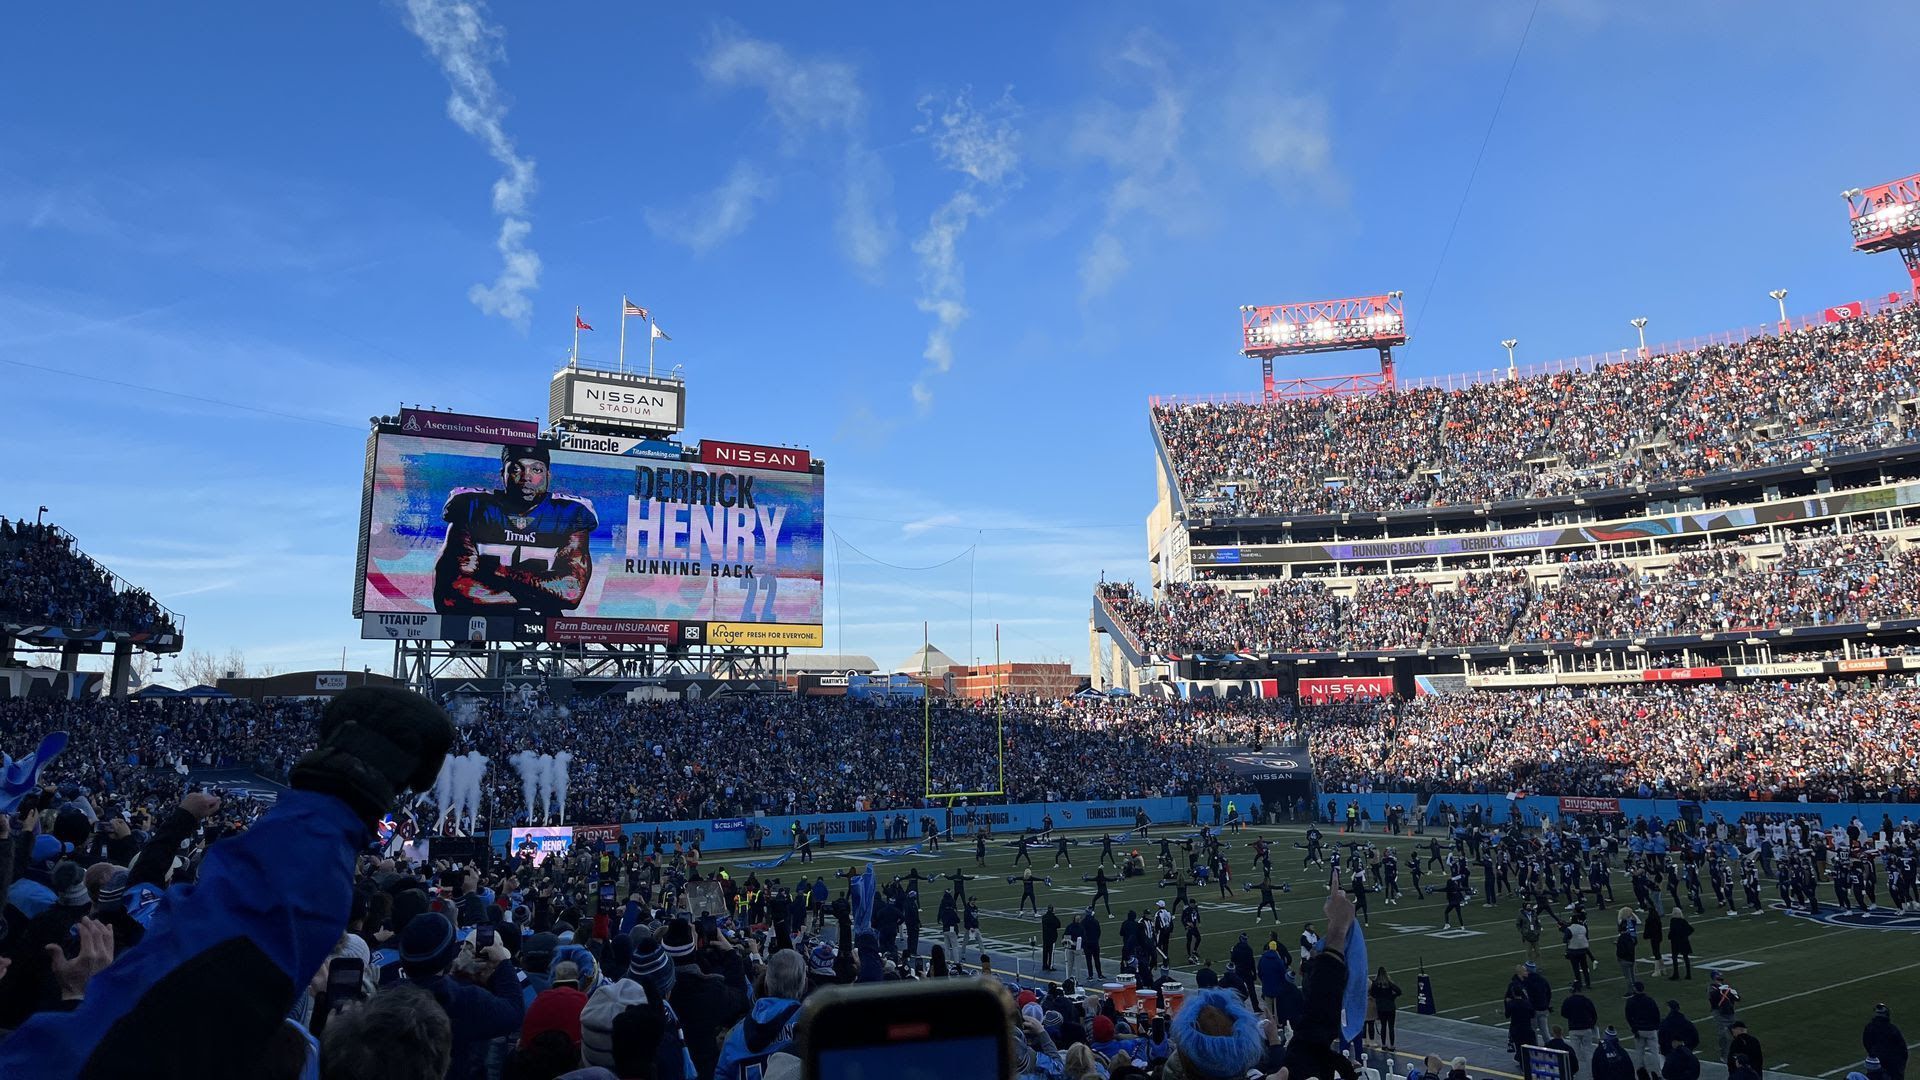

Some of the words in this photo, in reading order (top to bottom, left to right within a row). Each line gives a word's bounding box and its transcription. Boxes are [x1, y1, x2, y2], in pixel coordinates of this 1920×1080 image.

[586, 388, 664, 407] NISSAN
[599, 403, 651, 416] STADIUM
[424, 420, 473, 433] Ascension
[474, 424, 499, 436] Saint
[500, 428, 537, 439] Thomas
[561, 433, 619, 453] Pinnacle
[632, 448, 680, 459] TitansBanking.com
[716, 447, 796, 466] NISSAN
[634, 464, 756, 510] DERRICK
[625, 494, 788, 565] HENRY
[1461, 536, 1505, 551] DERRICK
[1506, 532, 1540, 547] HENRY
[1352, 543, 1397, 557] RUNNING
[1399, 541, 1426, 555] BACK
[625, 558, 701, 577] RUNNING
[710, 562, 754, 579] BACK
[740, 574, 778, 623] 22
[379, 614, 410, 625] TITAN
[412, 615, 428, 625] UP
[471, 620, 485, 630] Lite
[523, 623, 544, 634] 7:44
[554, 621, 578, 631] Farm
[580, 621, 613, 632] Bureau
[614, 622, 670, 633] INSURANCE
[686, 627, 699, 639] 25
[712, 624, 744, 644] Kroger
[746, 631, 767, 639] FRESH
[1770, 665, 1817, 674] Tennessee
[1311, 683, 1381, 694] NISSAN
[1564, 799, 1615, 810] DIVISIONAL
[541, 839, 568, 851] HENRY
